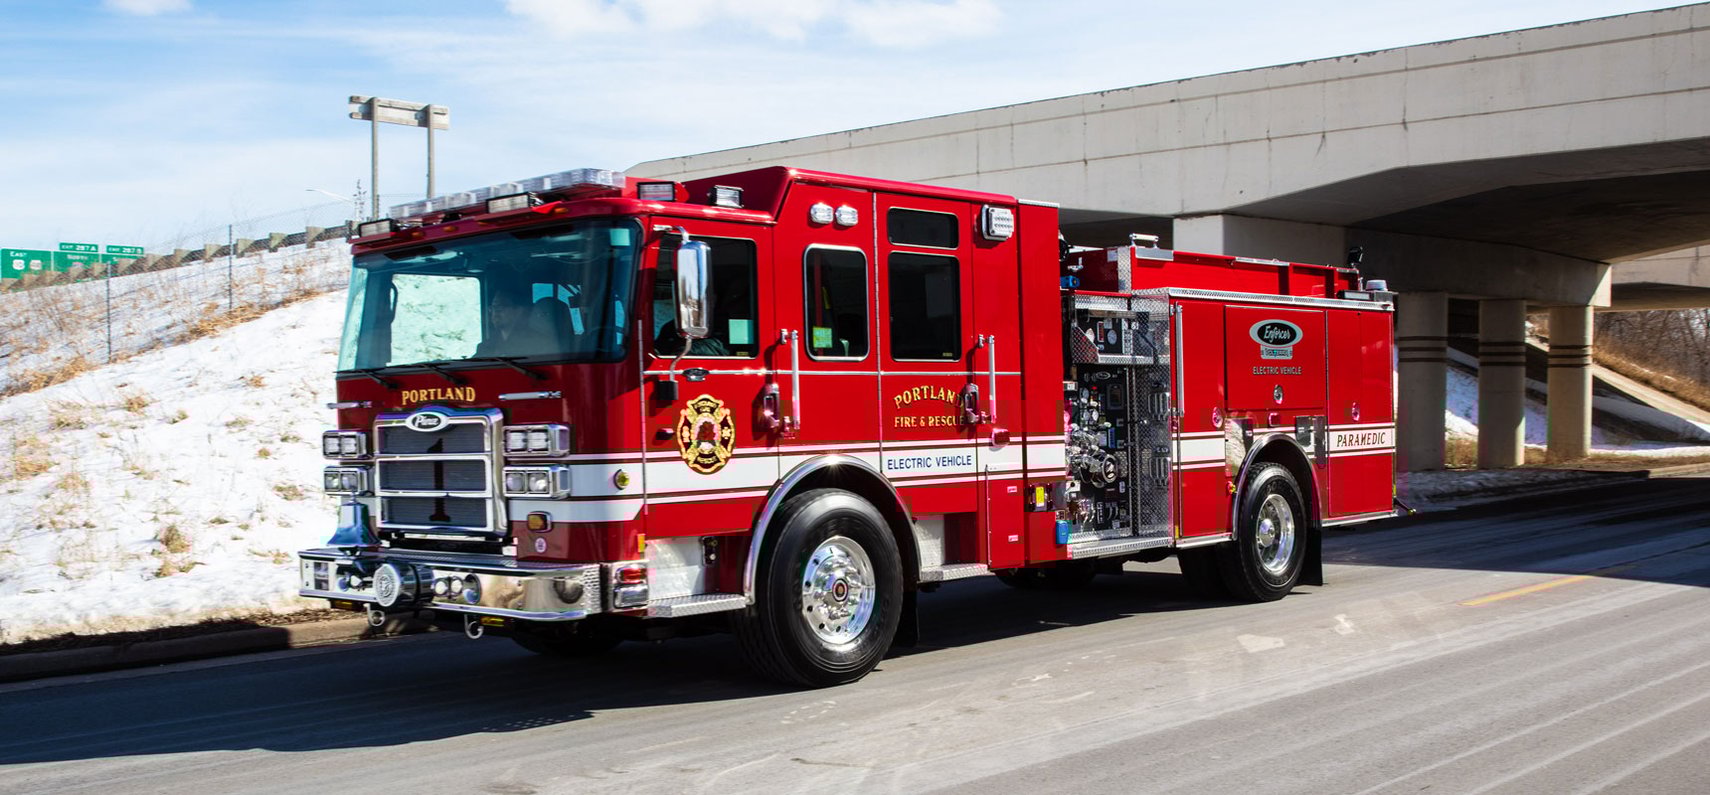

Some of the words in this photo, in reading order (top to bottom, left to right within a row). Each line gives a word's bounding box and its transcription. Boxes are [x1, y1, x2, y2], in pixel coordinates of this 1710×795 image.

[1252, 366, 1279, 375] ELECTRIC
[1280, 366, 1302, 375] VEHICLE
[401, 386, 476, 406] PORTLAND
[894, 416, 917, 428] FIRE
[919, 416, 926, 427] &
[928, 415, 965, 427] RESCUE
[1336, 431, 1386, 447] PARAMEDIC
[887, 457, 932, 470] ELECTRIC
[935, 455, 972, 467] VEHICLE
